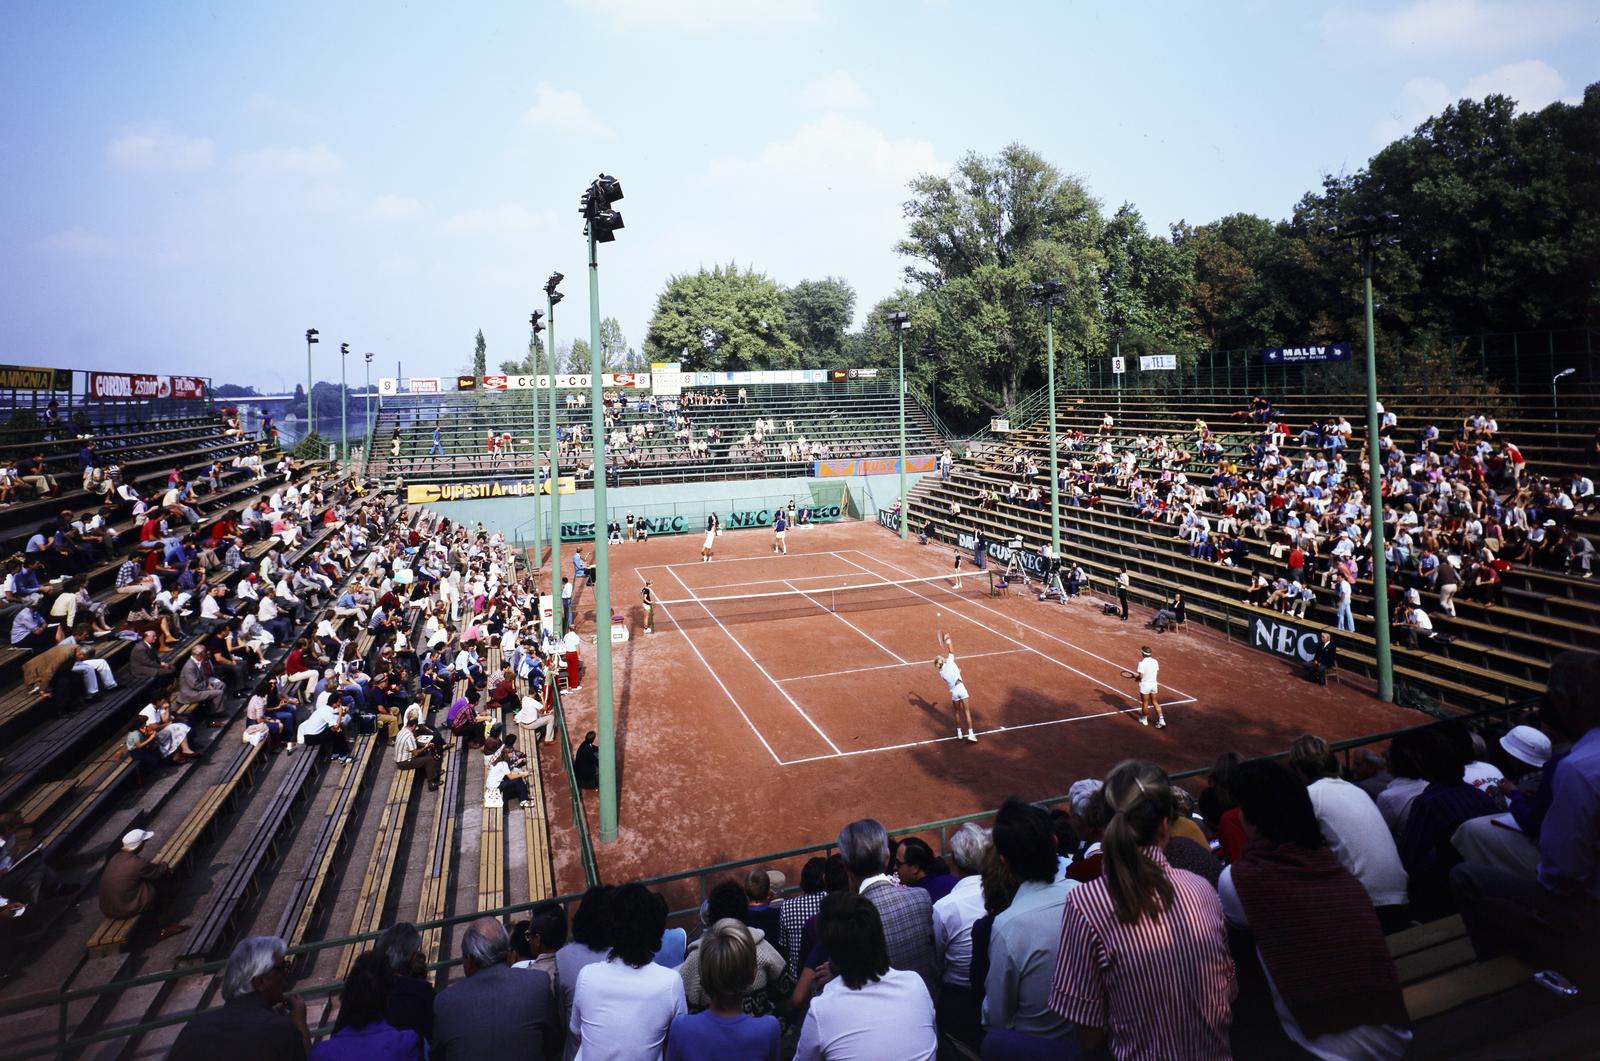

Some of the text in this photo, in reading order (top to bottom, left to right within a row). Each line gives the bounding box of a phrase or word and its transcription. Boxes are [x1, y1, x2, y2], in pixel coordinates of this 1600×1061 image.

[645, 516, 683, 532] NEC
[730, 510, 768, 527] NEC
[881, 511, 898, 530] NEC
[561, 523, 596, 537] IVEC
[1256, 618, 1319, 663] NEC
